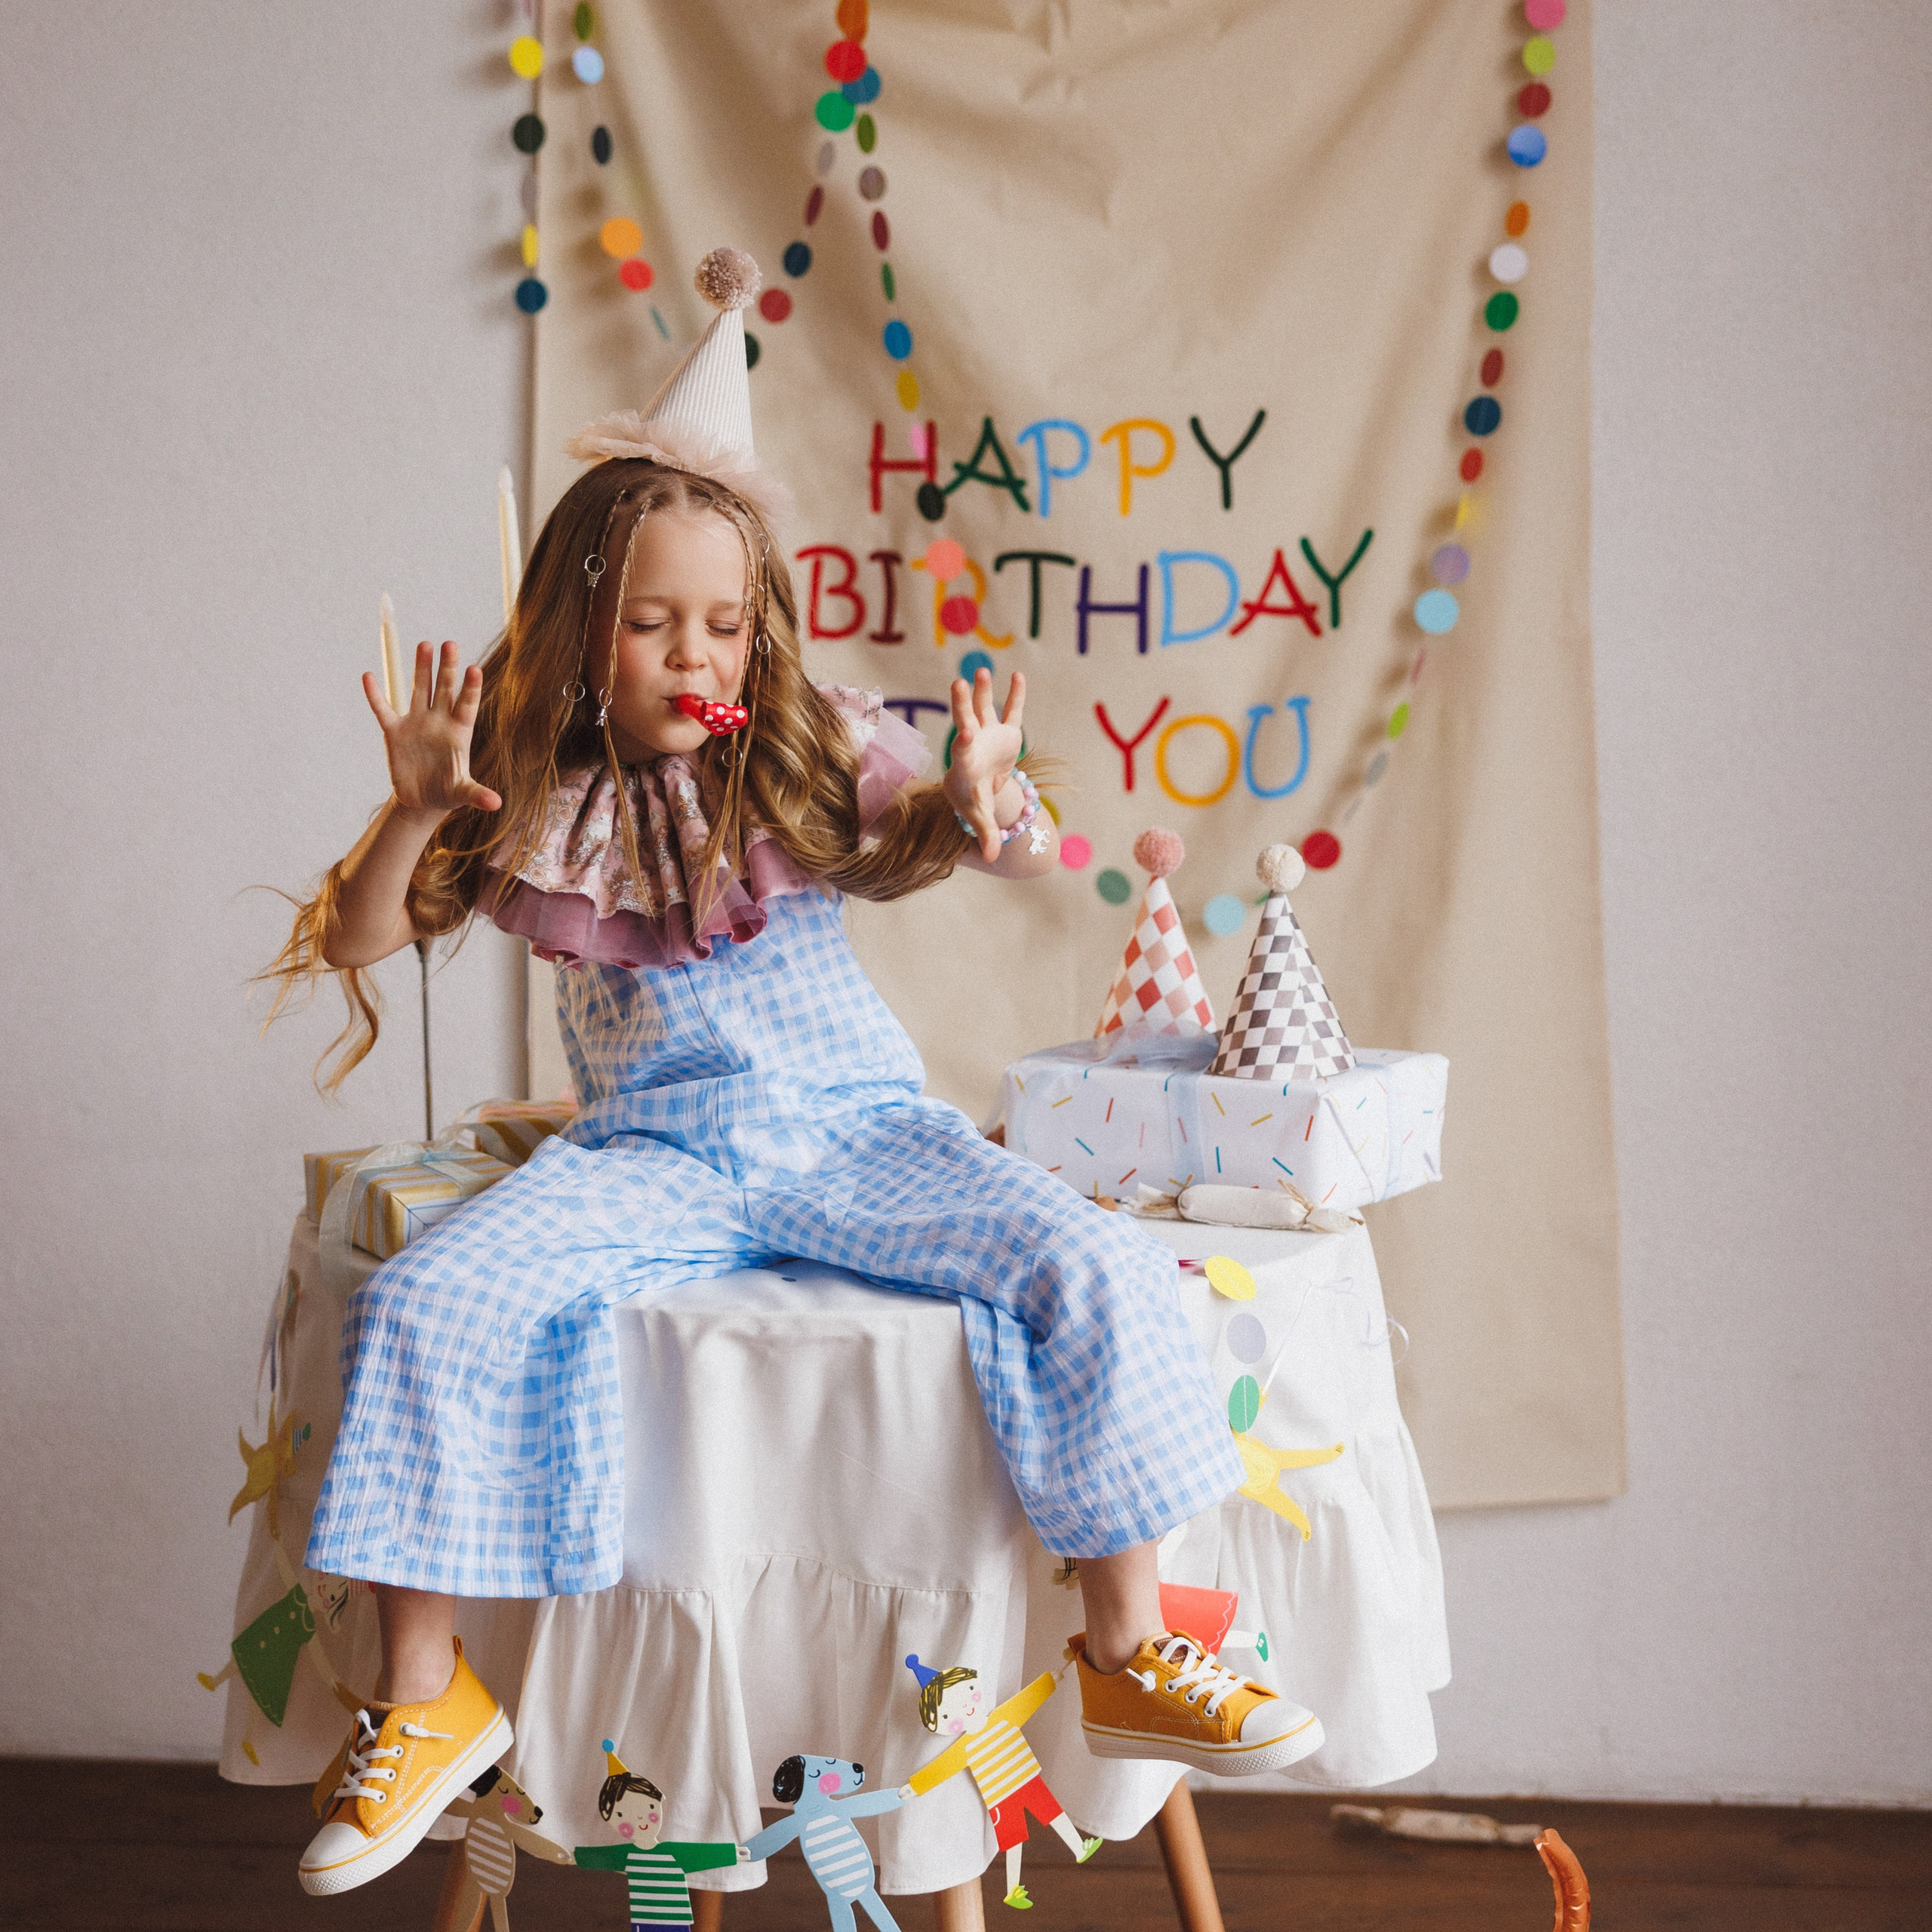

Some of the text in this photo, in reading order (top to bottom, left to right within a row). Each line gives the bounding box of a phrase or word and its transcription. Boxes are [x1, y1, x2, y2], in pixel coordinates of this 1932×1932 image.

[869, 408, 1267, 518] HAPPY
[795, 528, 1374, 655] BIRTHDAY
[881, 694, 1312, 808] T YOU
